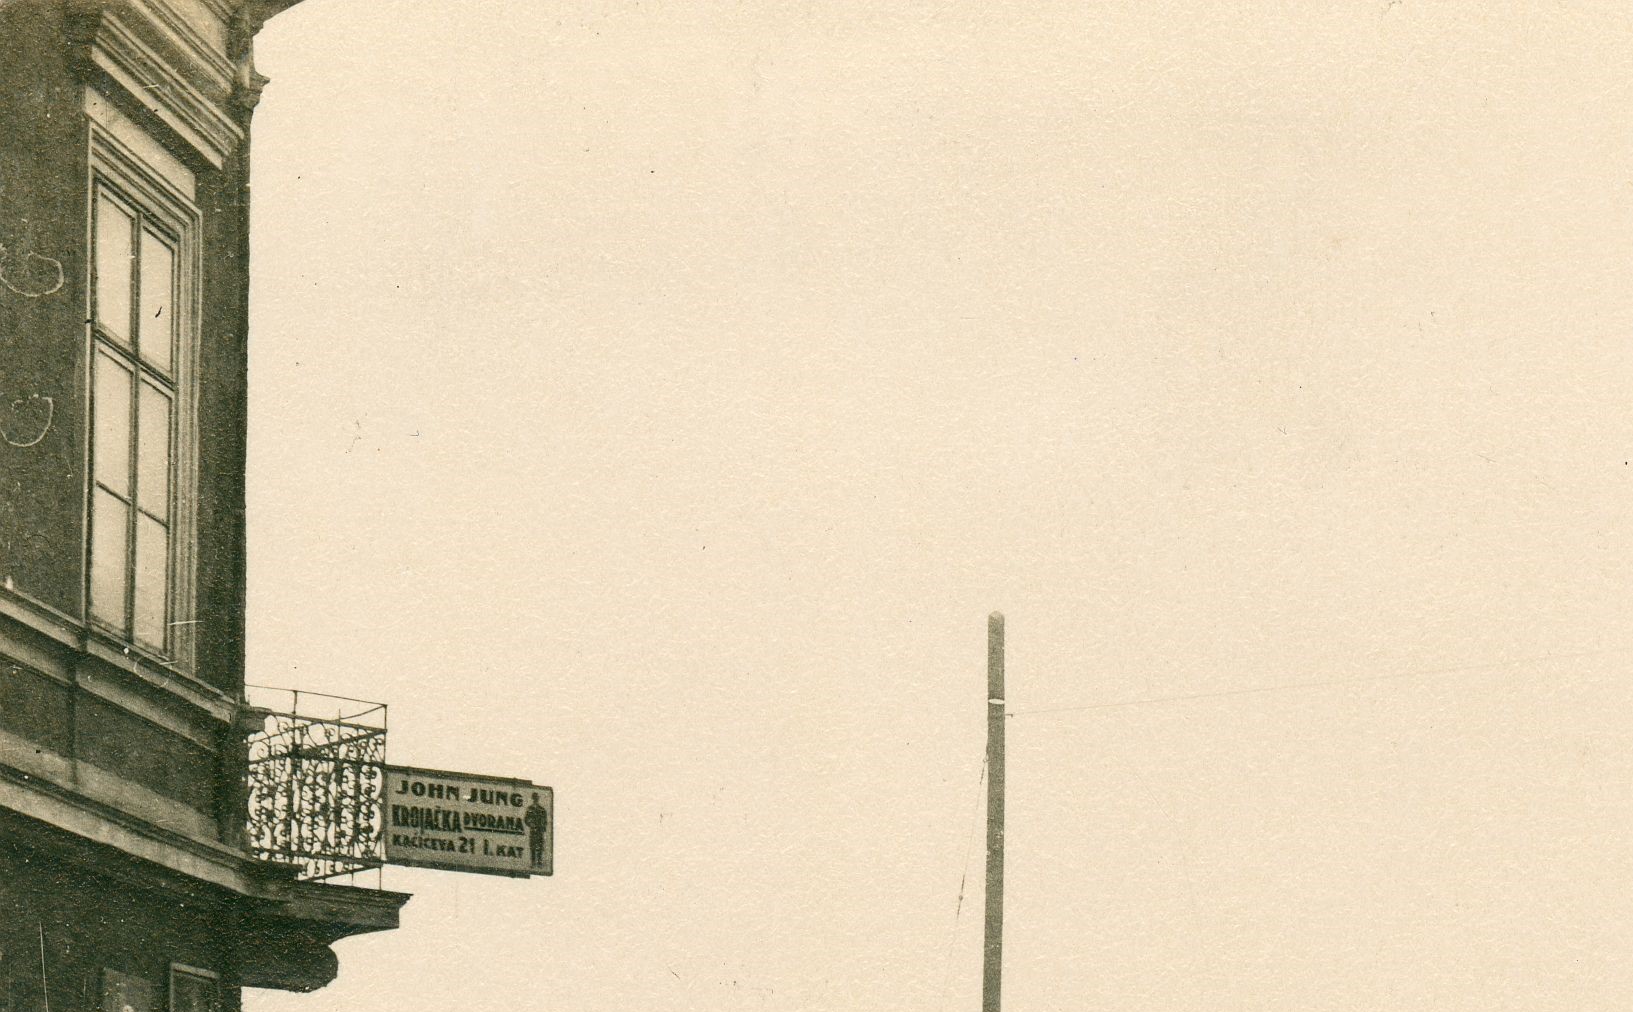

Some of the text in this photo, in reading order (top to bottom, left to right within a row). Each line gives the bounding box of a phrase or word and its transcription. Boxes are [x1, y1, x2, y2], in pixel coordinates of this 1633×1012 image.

[395, 780, 524, 808] JOHN JUNG
[463, 811, 525, 831] DVORANA
[458, 836, 475, 854] 21
[496, 845, 525, 859] KAT
